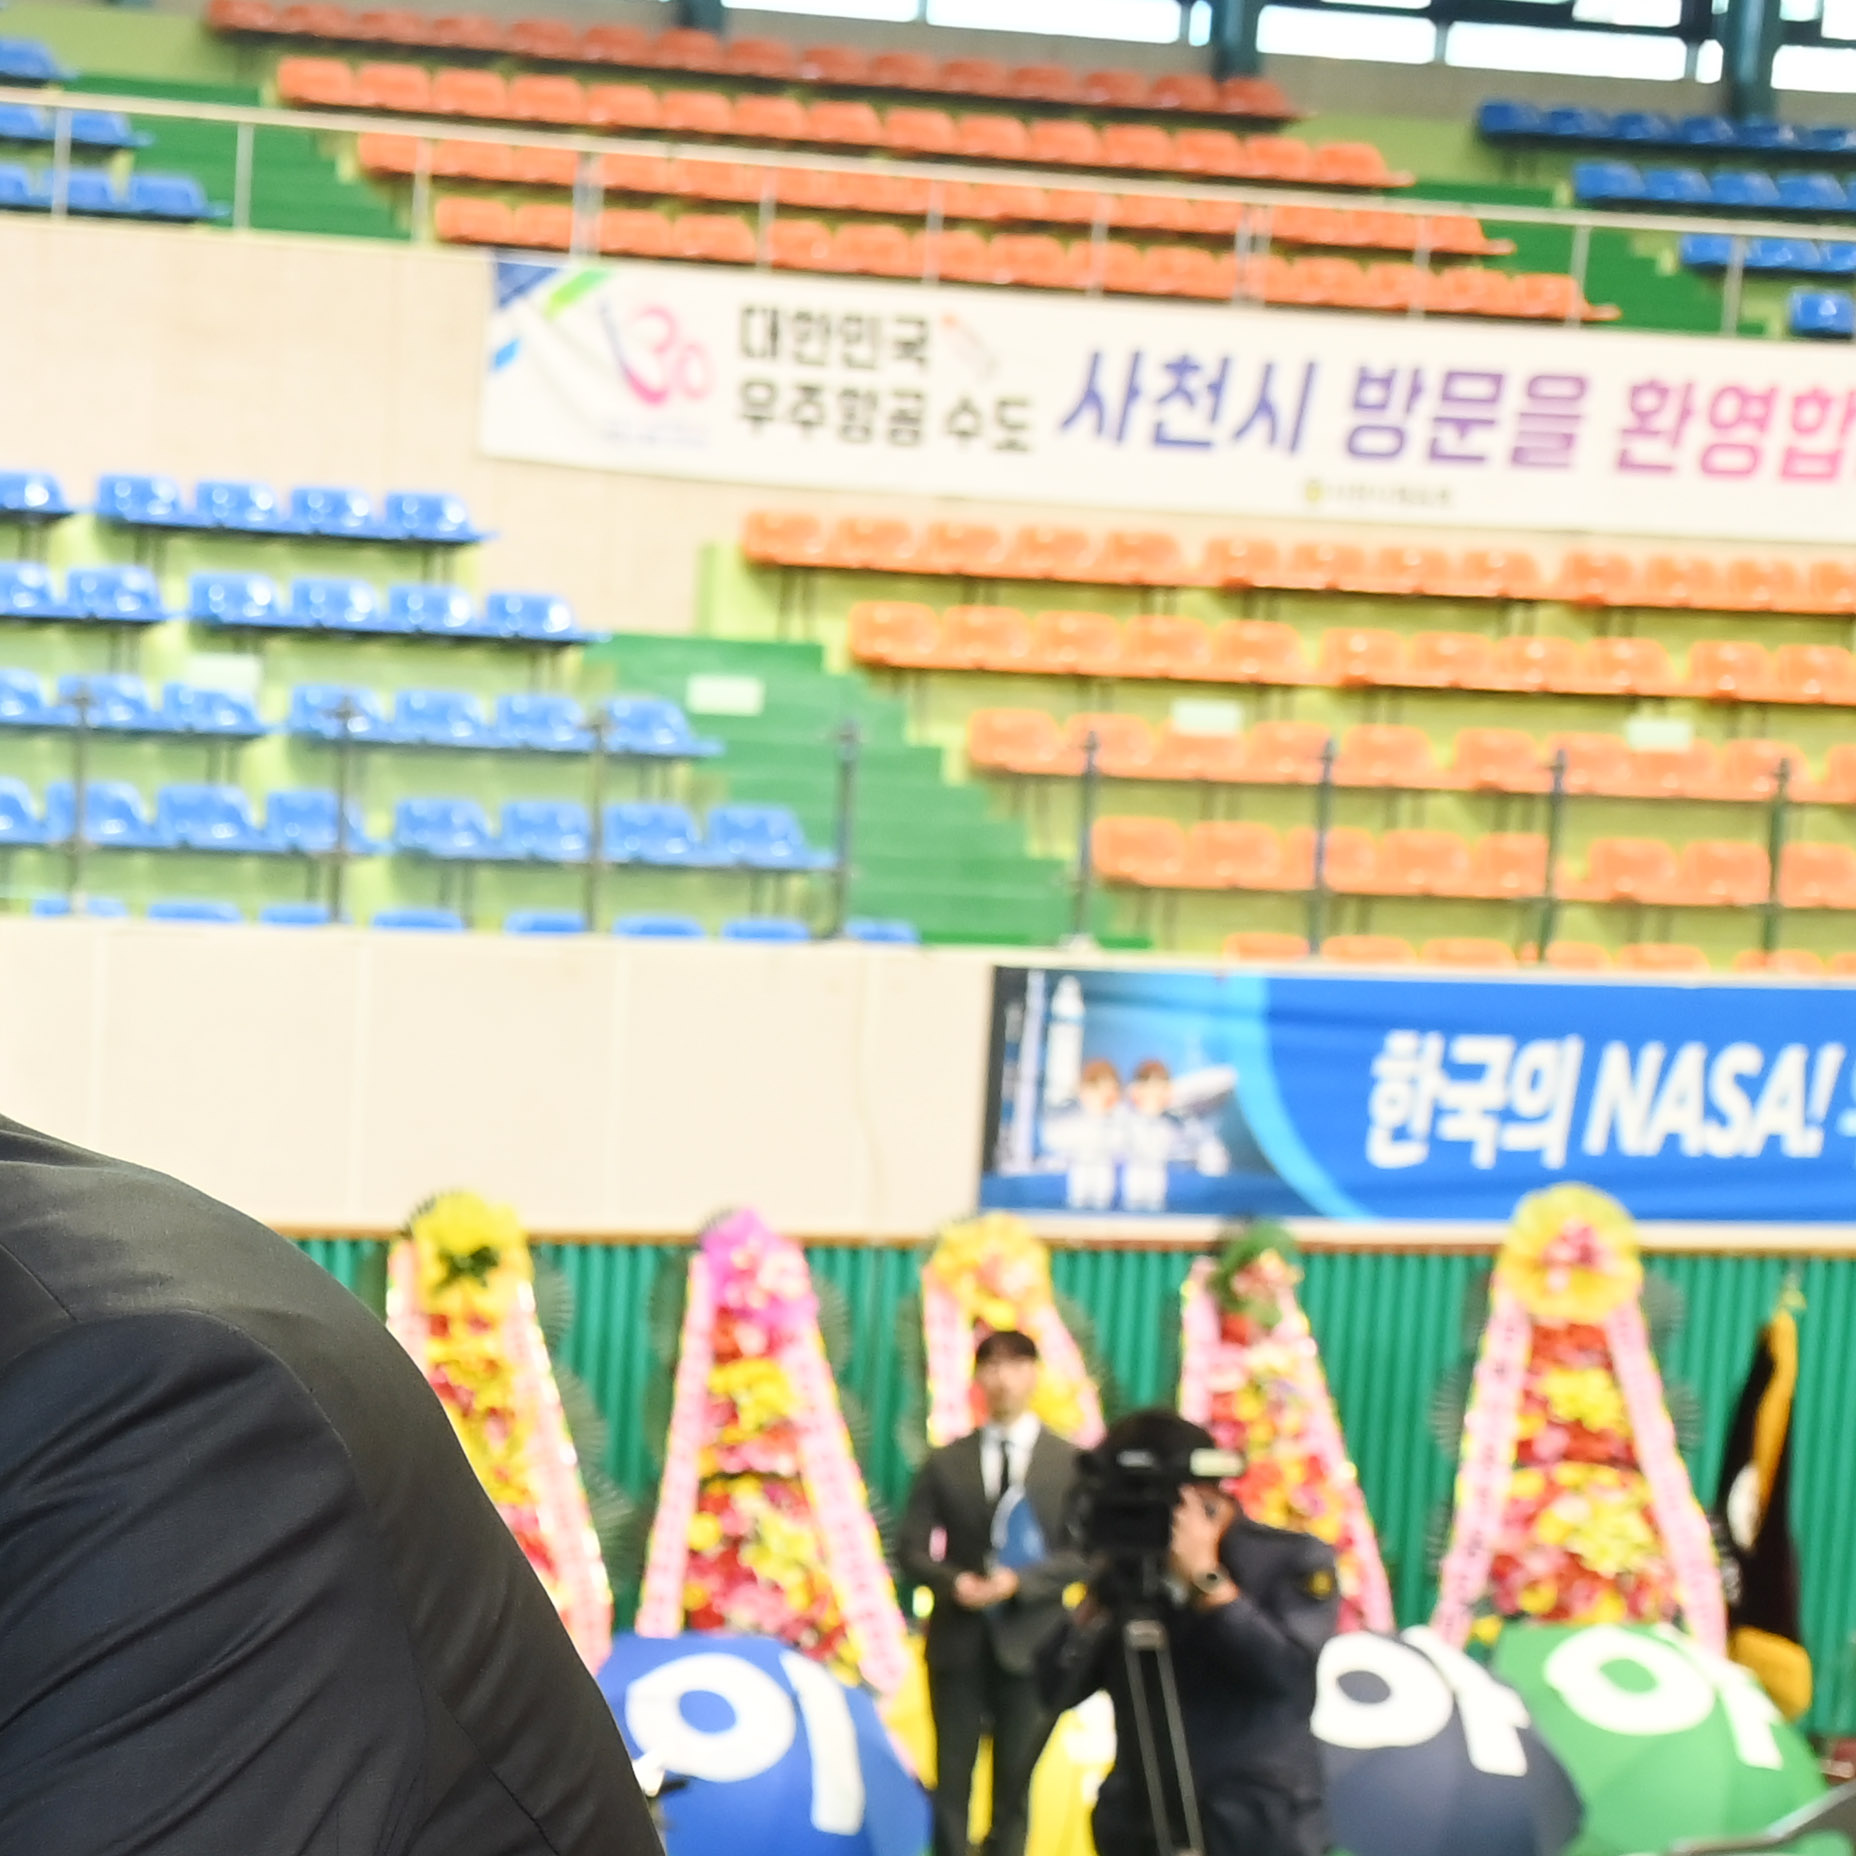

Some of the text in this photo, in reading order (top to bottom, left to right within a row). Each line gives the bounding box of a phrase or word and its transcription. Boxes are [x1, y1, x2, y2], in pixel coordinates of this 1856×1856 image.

[741, 304, 928, 373] 대한민국
[741, 379, 924, 446] 우주항공
[945, 396, 1033, 451] 수도
[1060, 350, 1856, 481] 사천시 방문을 환영합
[1365, 1028, 1846, 1170] 한국의 NASA!
